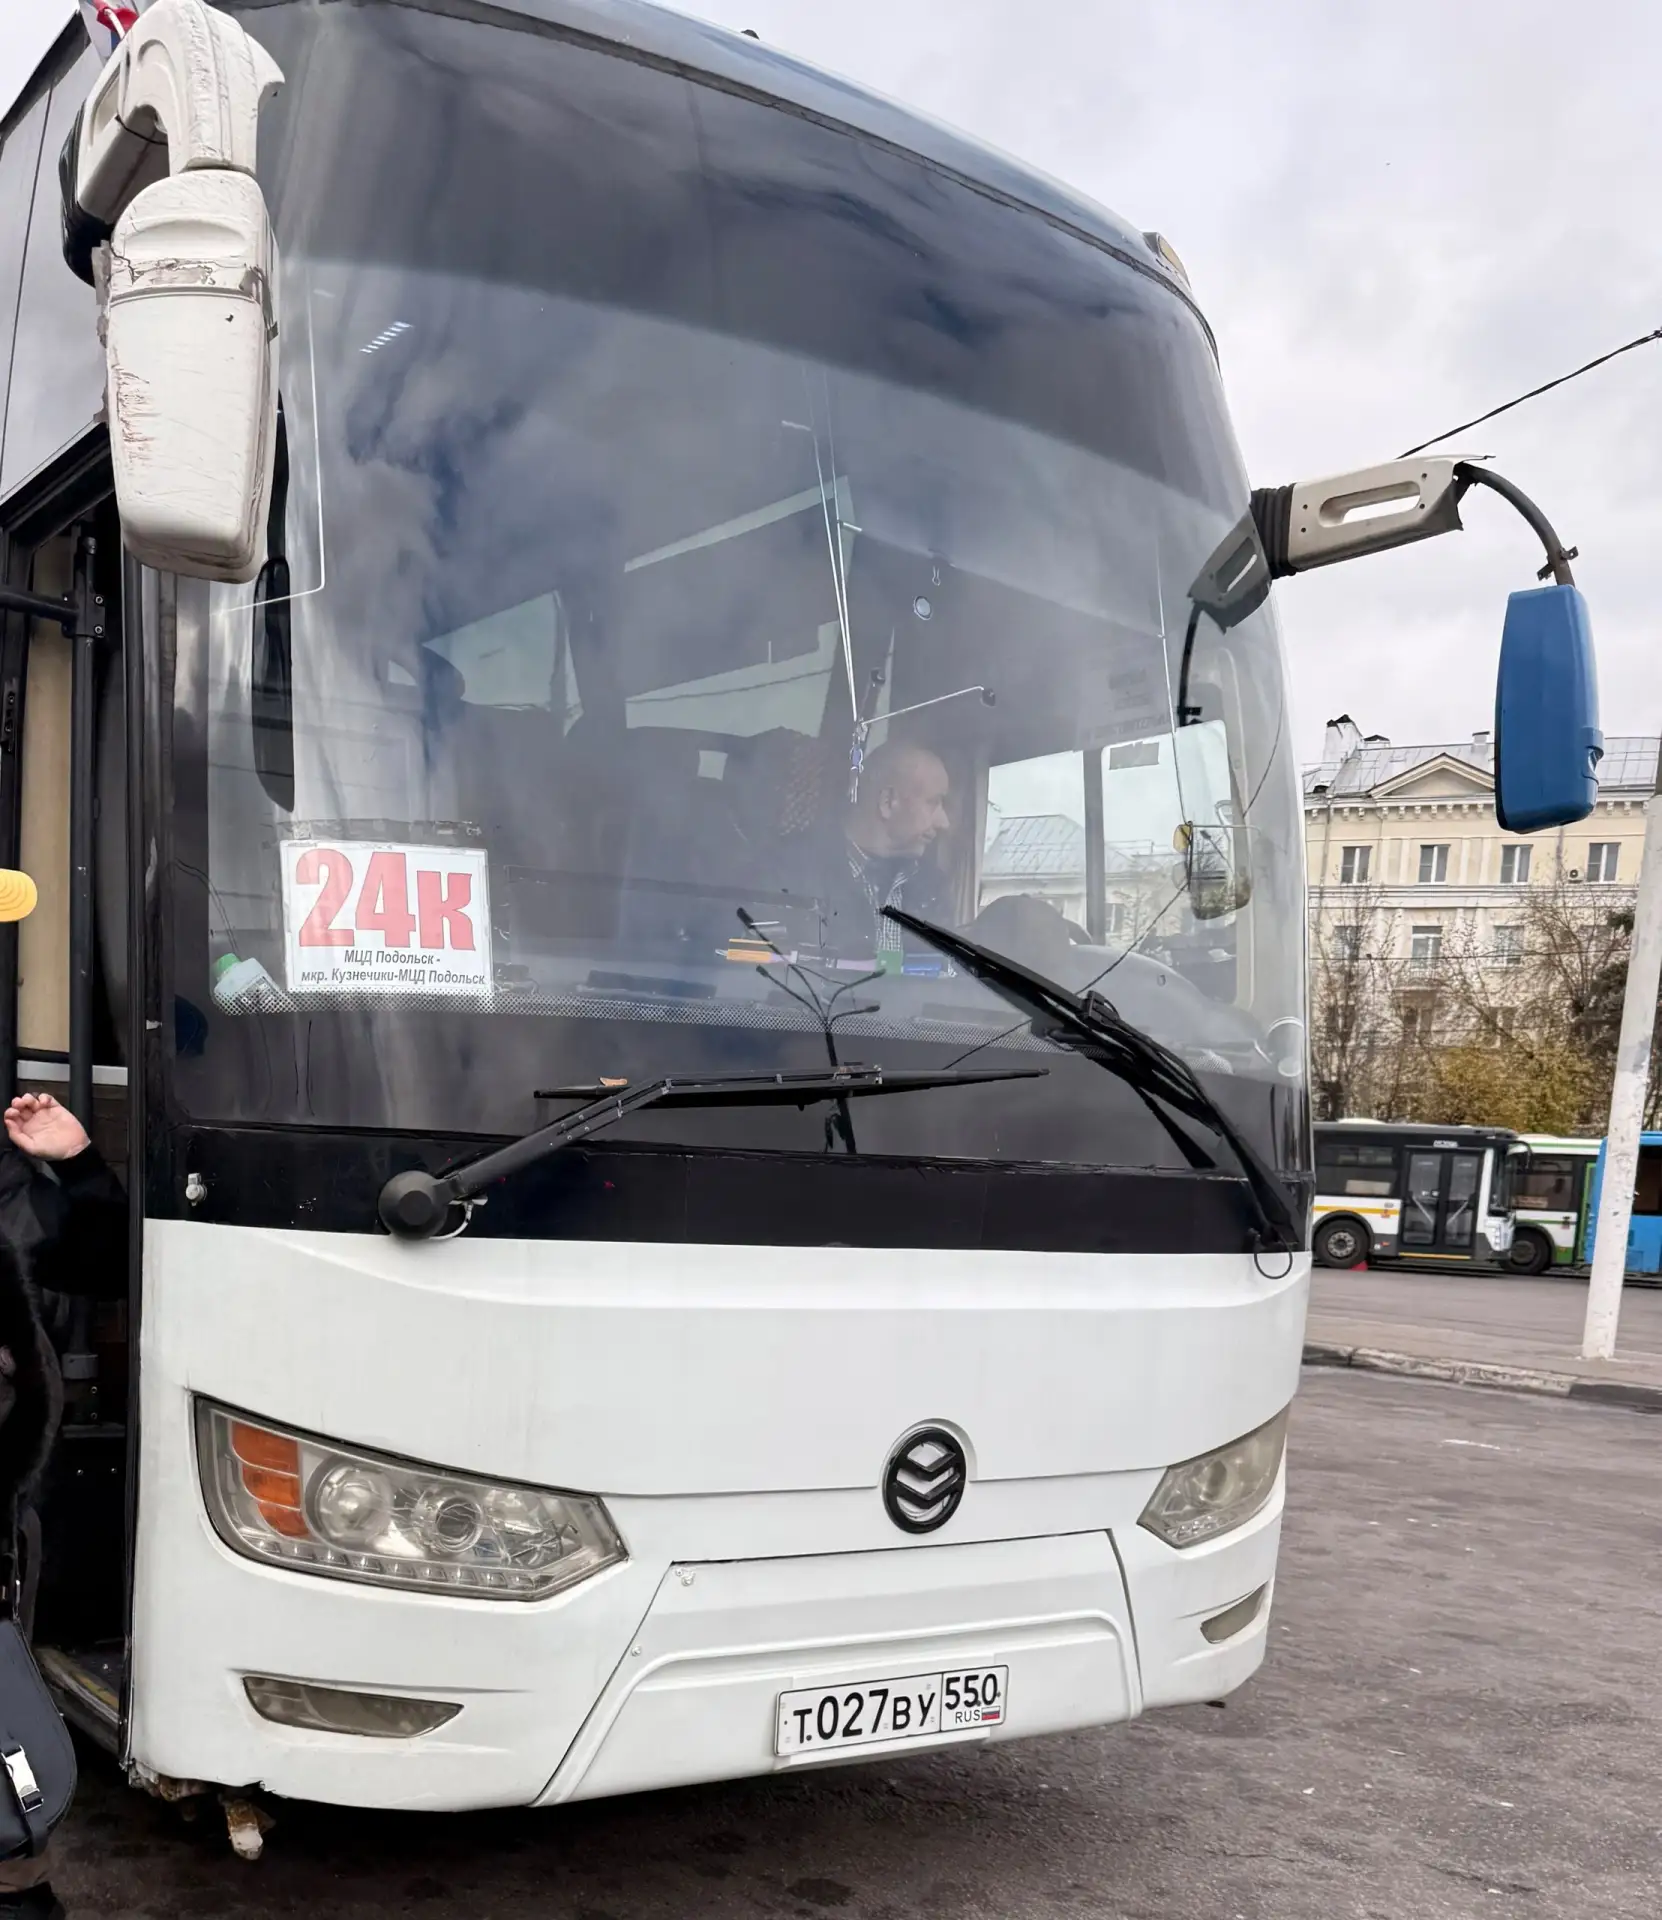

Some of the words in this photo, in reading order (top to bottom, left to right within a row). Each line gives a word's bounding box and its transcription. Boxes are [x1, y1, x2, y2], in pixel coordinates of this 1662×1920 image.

[344, 950, 372, 965] МЦД
[301, 971, 328, 984] мкр.
[428, 970, 485, 985] Подольск
[945, 1673, 998, 1711] 550
[955, 1709, 981, 1724] RUS
